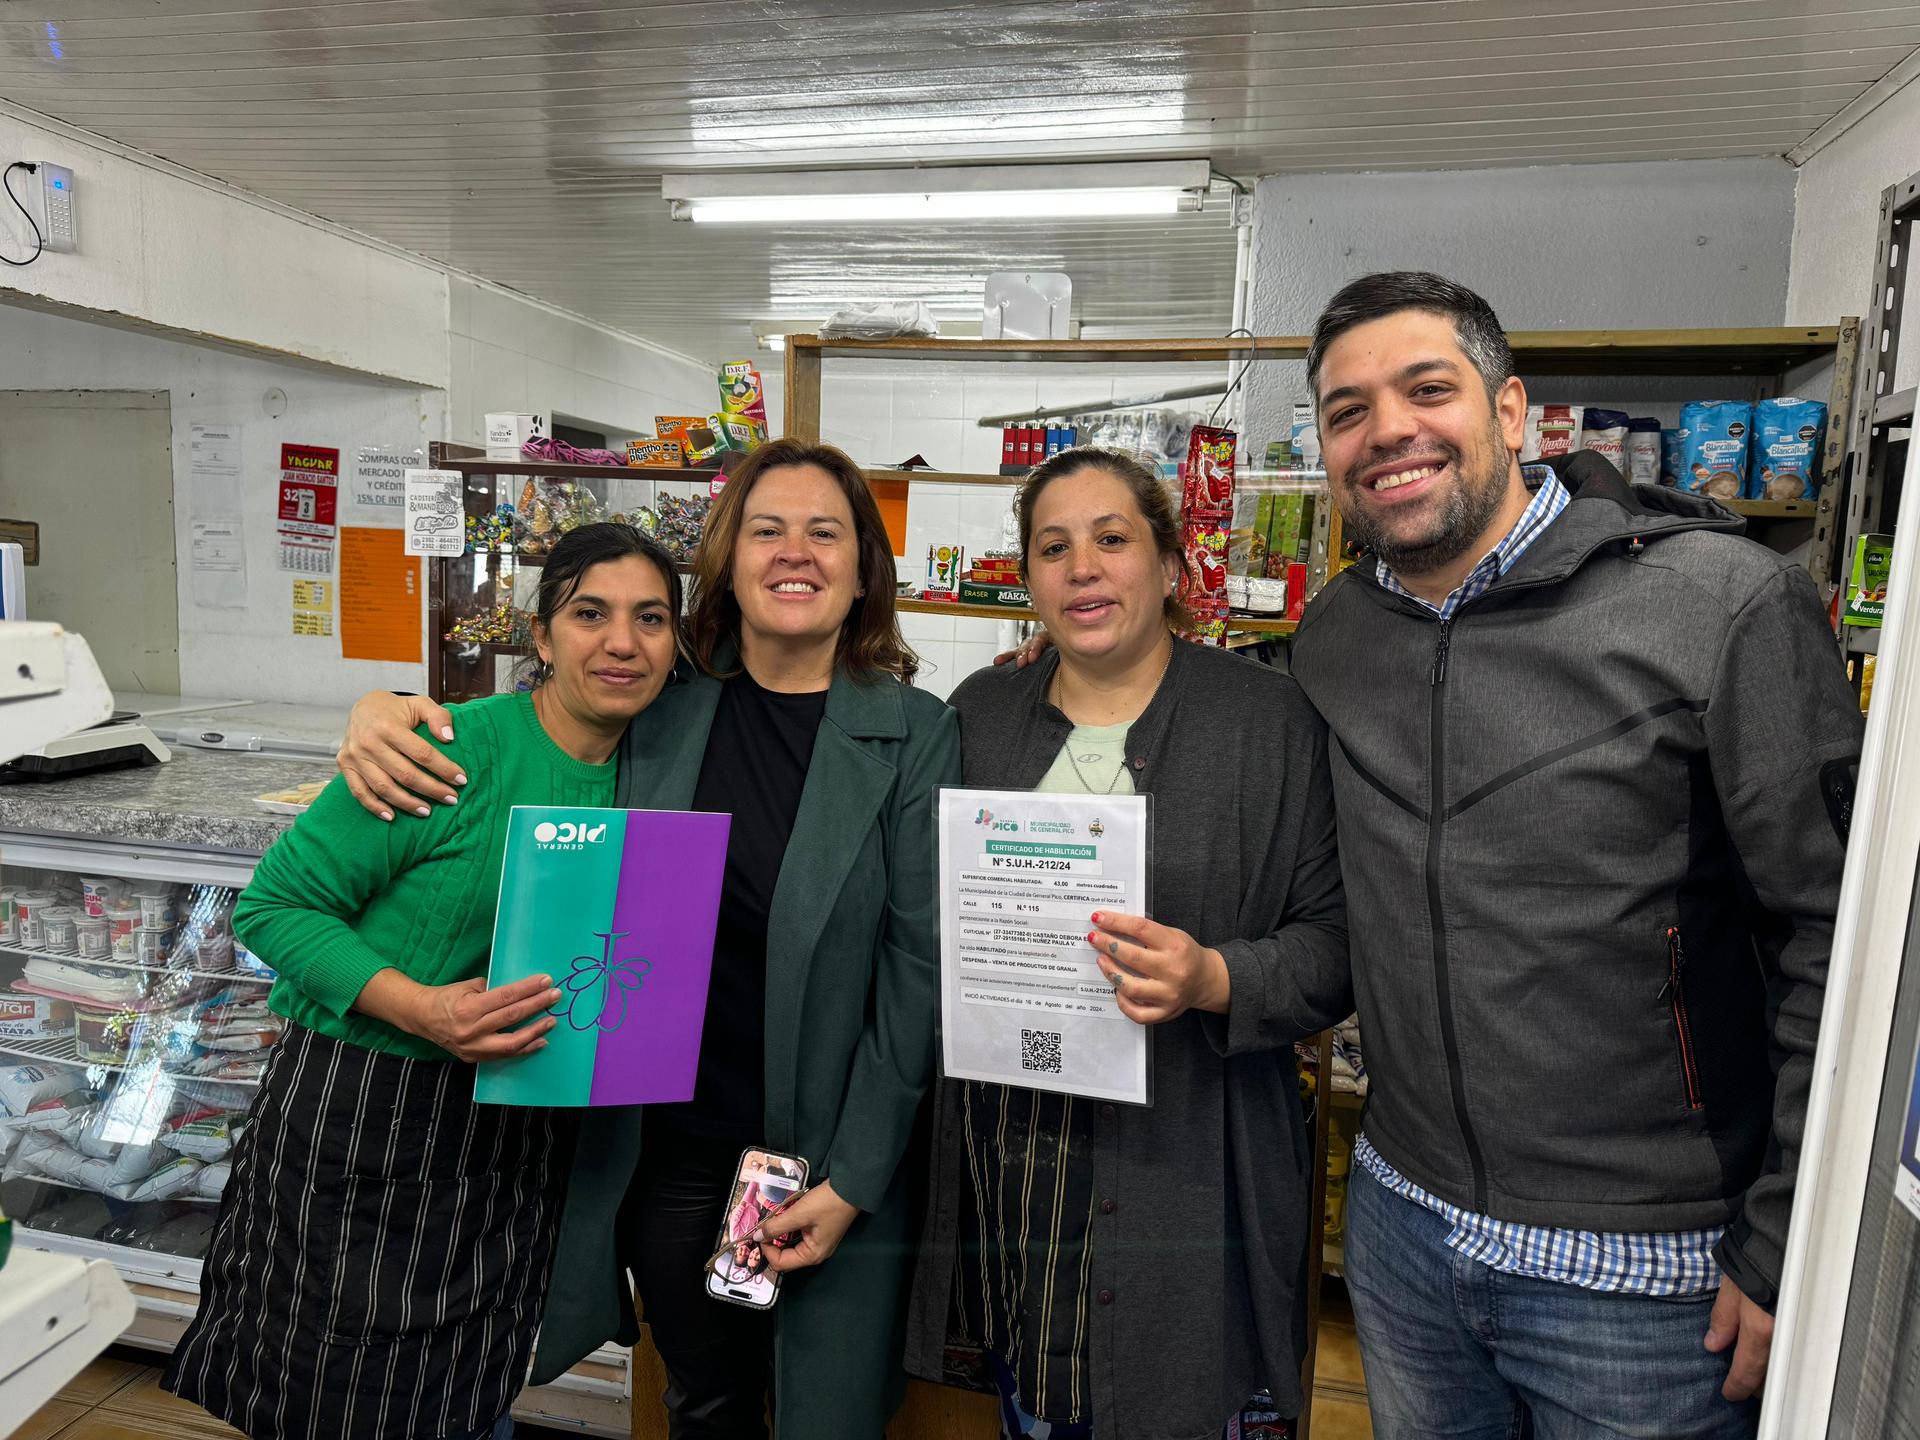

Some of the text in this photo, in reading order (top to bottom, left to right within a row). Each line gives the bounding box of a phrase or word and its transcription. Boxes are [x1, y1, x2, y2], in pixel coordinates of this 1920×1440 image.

[629, 443, 662, 455] mentho
[1536, 437, 1575, 453] Harina
[1705, 442, 1739, 451] Blancaflor
[1771, 445, 1807, 455] Blancaflor
[358, 454, 420, 466] COMPRAS CON
[629, 453, 649, 463] plus
[358, 468, 400, 477] MERCADO
[283, 488, 299, 502] 32
[357, 494, 374, 504] 15%
[375, 495, 386, 505] DE
[303, 501, 309, 514] 3
[964, 589, 989, 598] ERASER
[992, 822, 1019, 832] PICO
[1030, 821, 1071, 829] MUNICIPALIDAD
[533, 821, 607, 843] PICO
[991, 844, 1033, 853] CERTIFICADO
[1044, 847, 1092, 856] HABILITACIÓN
[1006, 858, 1071, 870] S.U.H.-212/24
[964, 887, 997, 895] Municipalidad
[1063, 894, 1090, 902] CERTIFICA
[1032, 931, 1058, 940] CASTAÑO
[976, 946, 1007, 954] HABILITADO
[961, 956, 988, 964] DESPENSA
[1017, 962, 1048, 970] PRODUCTOS
[1046, 983, 1070, 991] Expediente
[965, 992, 979, 1000] INICIÓ
[980, 994, 1010, 1003] ACTIVIDADES
[1044, 1001, 1062, 1009] Agosto
[0, 1001, 32, 1015] far
